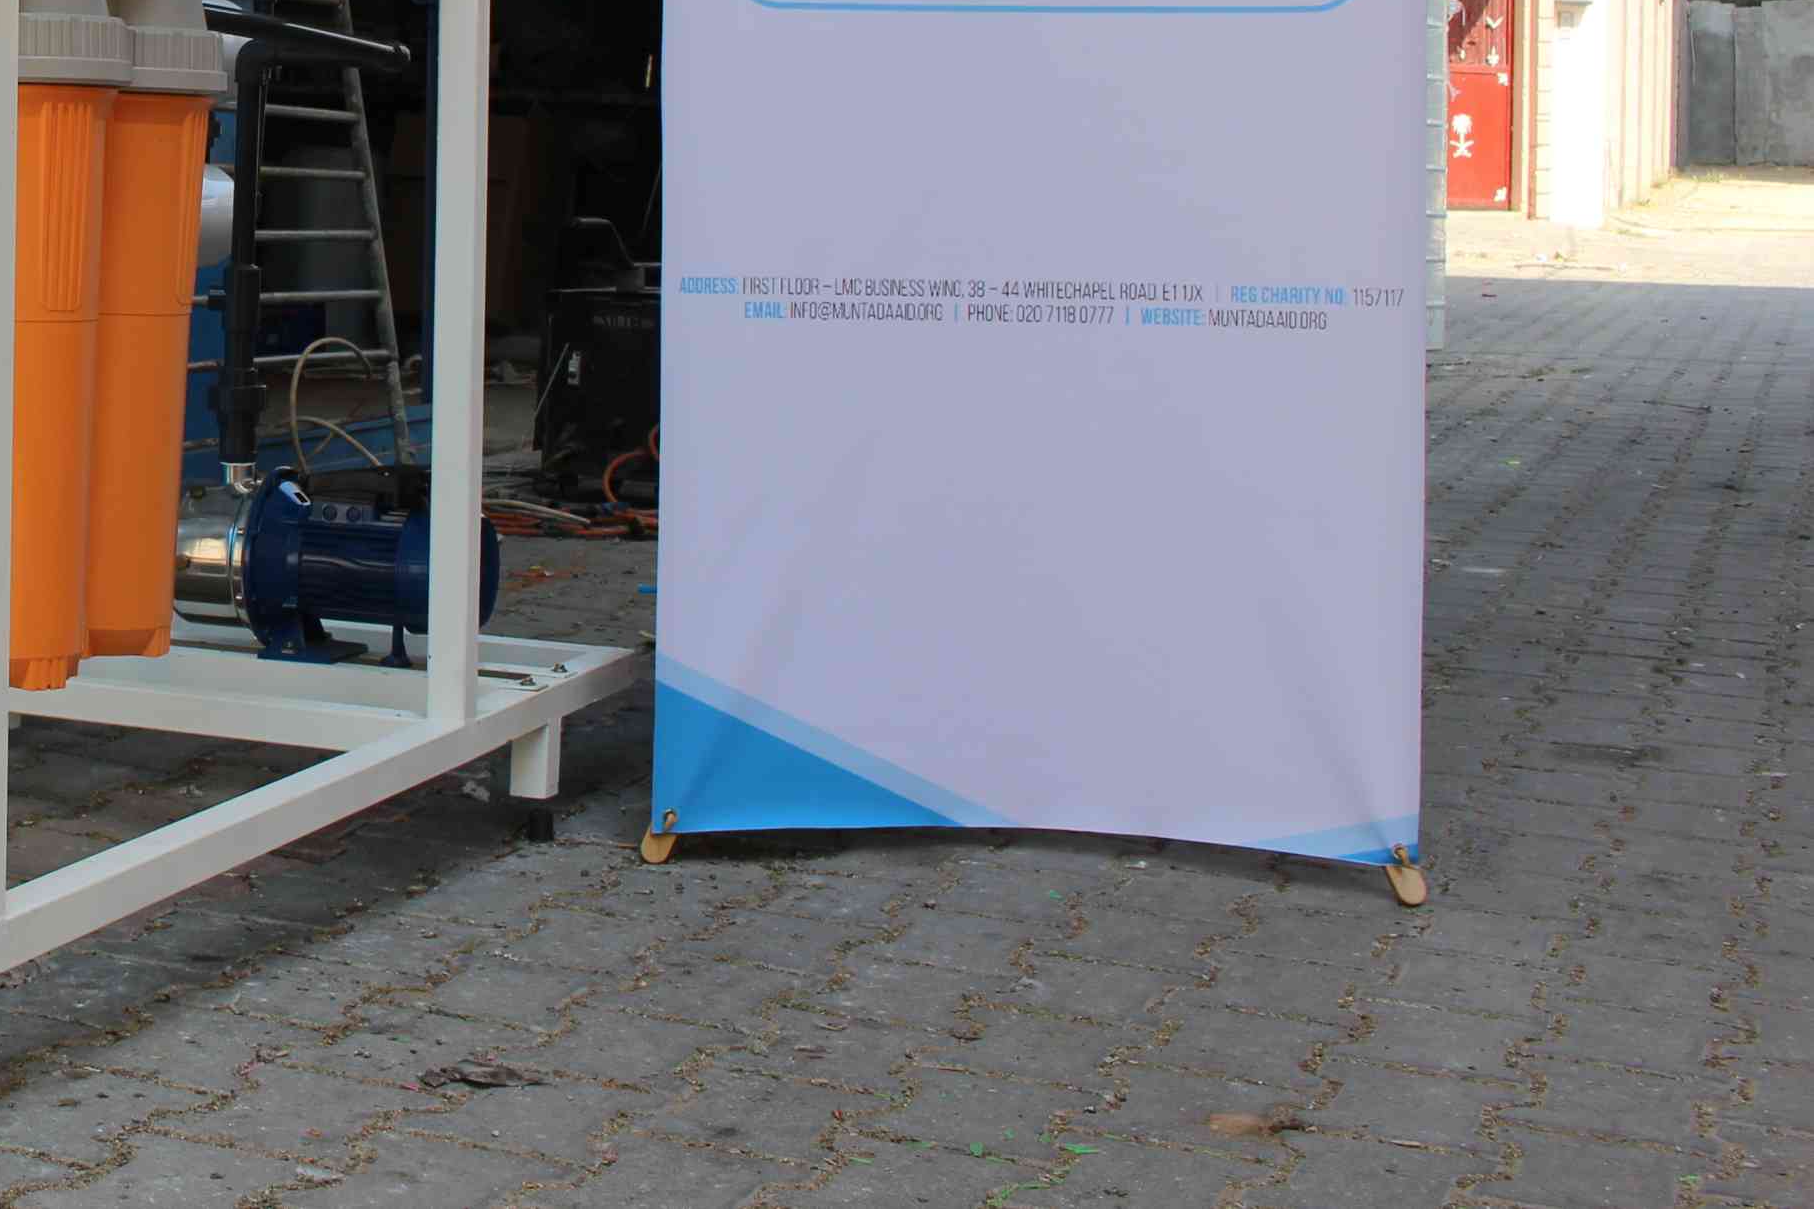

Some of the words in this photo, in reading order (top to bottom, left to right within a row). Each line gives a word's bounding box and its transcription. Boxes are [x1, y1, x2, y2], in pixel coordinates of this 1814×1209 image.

[742, 277, 778, 295] FIRST
[781, 277, 819, 296] FLOOR
[835, 278, 862, 296] LMC
[865, 278, 925, 298] BUSINESS
[968, 279, 985, 298] 38
[1001, 280, 1019, 298] 44
[1023, 280, 1116, 301] WHITECHAPEL
[1120, 282, 1157, 302] ROAD
[1162, 284, 1177, 302] E1
[1182, 284, 1203, 303] 1JX
[1261, 285, 1319, 305] CHARITY
[790, 301, 943, 321] INFO@MUNTADAAID.ORG
[1017, 304, 1043, 324] 020
[1047, 305, 1076, 325] 7118
[1079, 305, 1115, 325] 0777
[1208, 309, 1328, 331] MUNTADAAID.ORG
